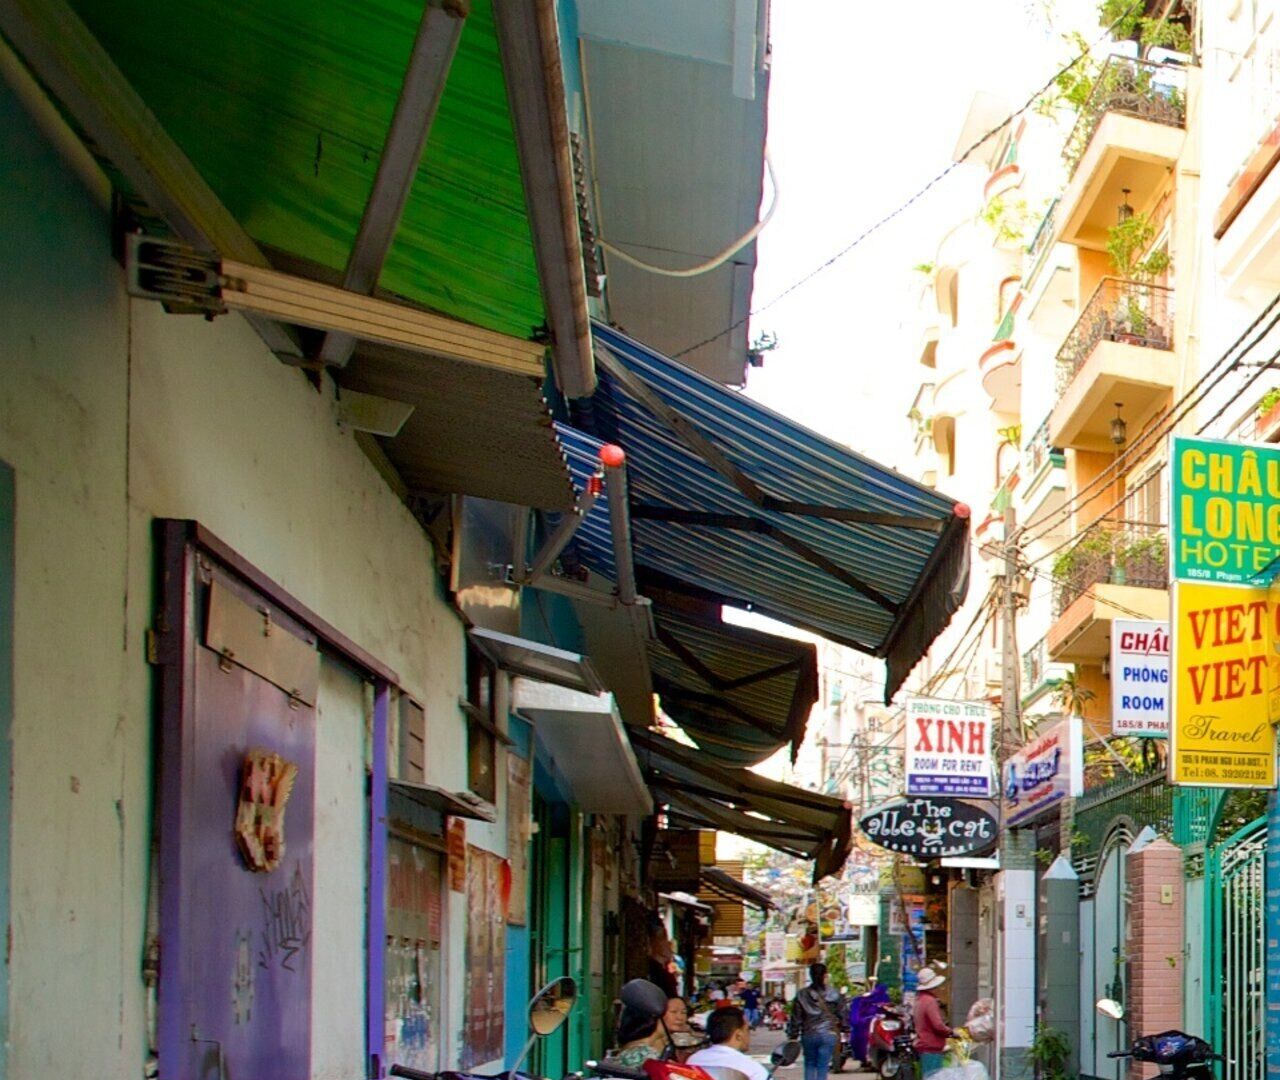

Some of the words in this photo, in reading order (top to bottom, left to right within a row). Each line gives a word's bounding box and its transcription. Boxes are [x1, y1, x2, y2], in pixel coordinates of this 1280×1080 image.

[1187, 600, 1269, 651] VIET
[1123, 664, 1168, 684] PHÒNG
[1187, 654, 1269, 705] VIET
[1122, 695, 1165, 711] ROOM
[1117, 719, 1144, 729] 185/8
[1182, 714, 1268, 744] Travel
[914, 717, 986, 755] XINH
[913, 757, 939, 771] ROOM
[941, 758, 958, 772] FOR
[960, 760, 983, 773] RENT
[906, 798, 952, 818] The
[948, 817, 991, 839] cat
